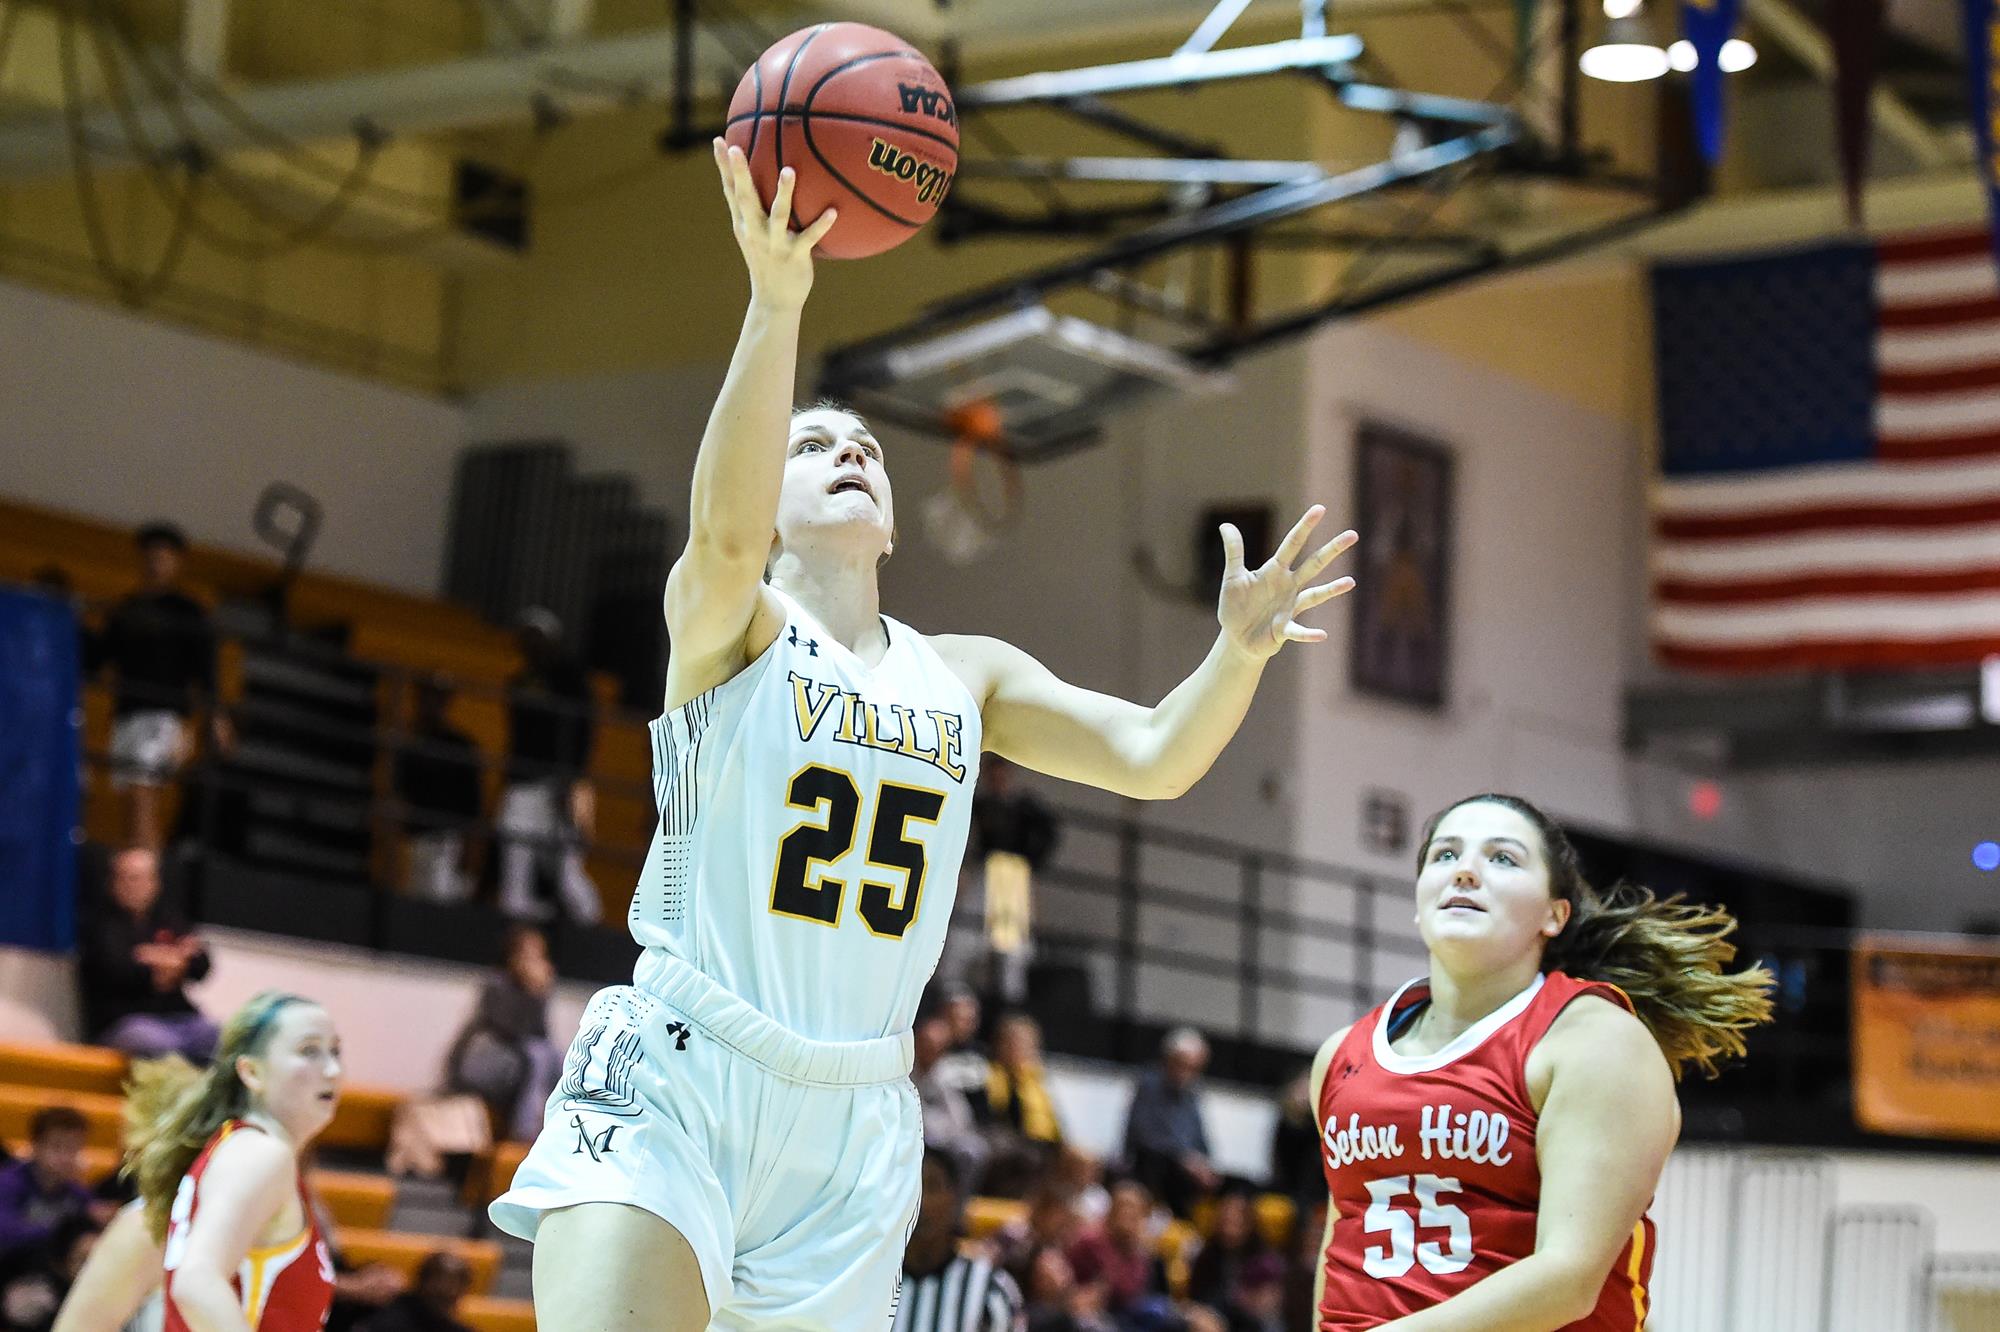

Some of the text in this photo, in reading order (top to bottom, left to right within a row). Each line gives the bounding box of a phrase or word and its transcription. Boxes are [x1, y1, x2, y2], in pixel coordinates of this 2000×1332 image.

[787, 669, 967, 784] VILLE
[769, 762, 948, 940] 25
[1323, 1104, 1513, 1170] Seton Hill
[1362, 1173, 1476, 1279] 55
